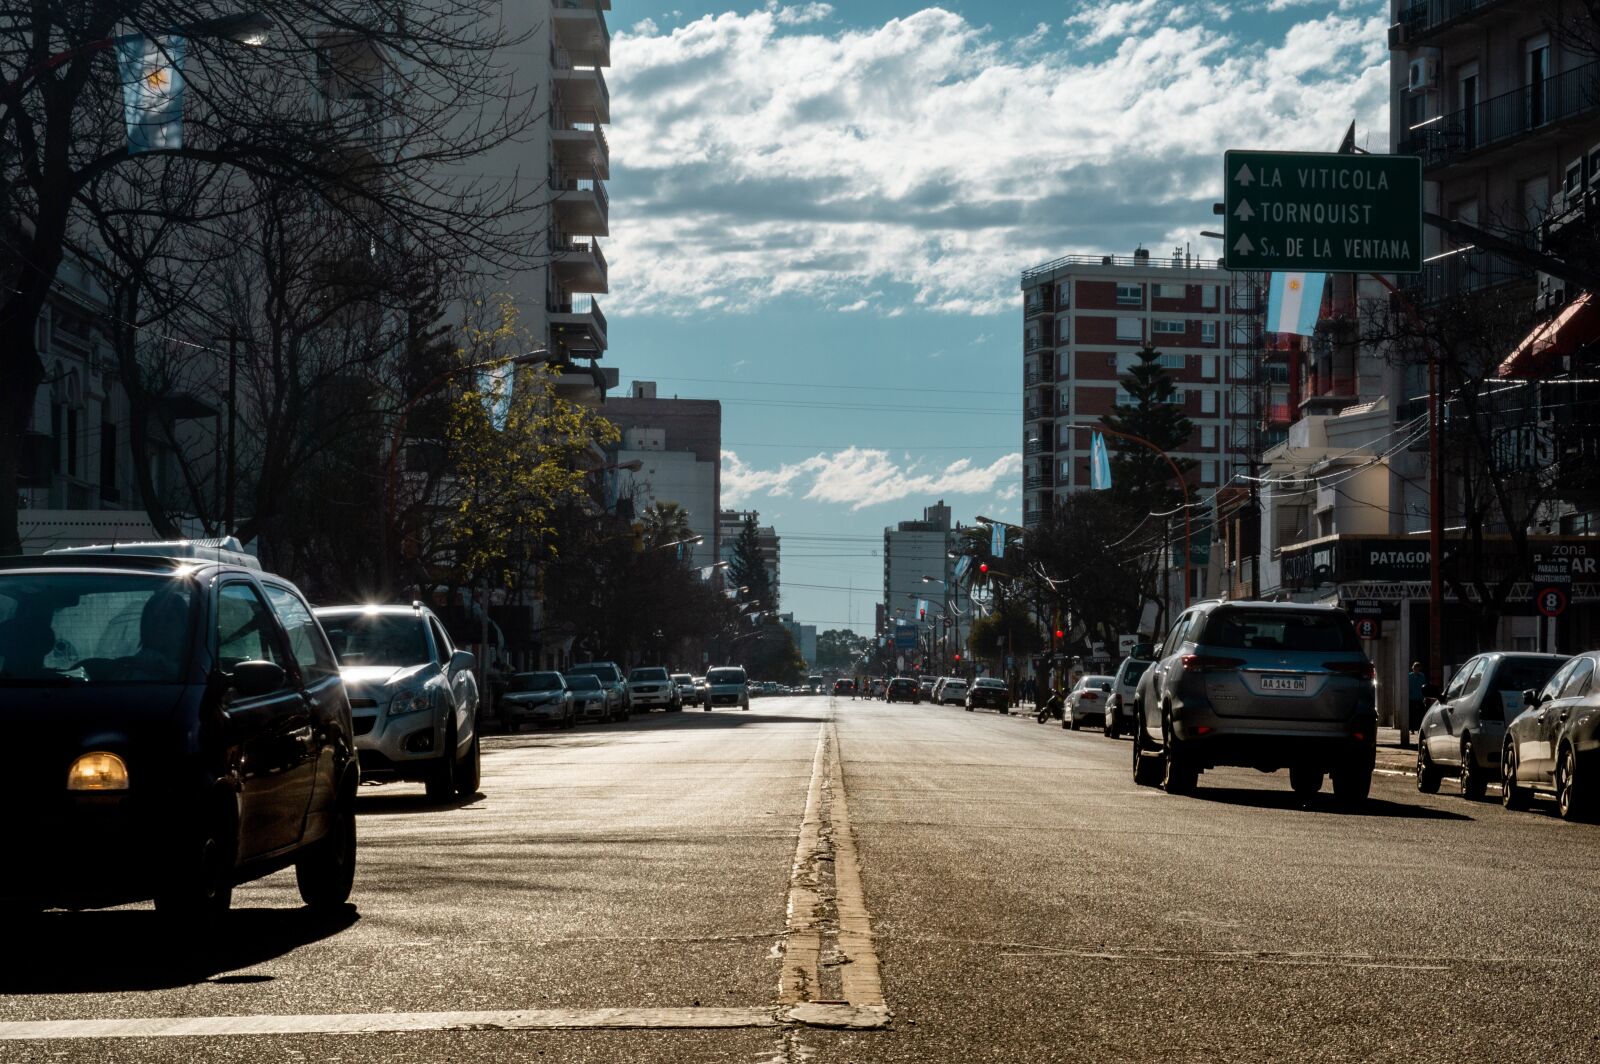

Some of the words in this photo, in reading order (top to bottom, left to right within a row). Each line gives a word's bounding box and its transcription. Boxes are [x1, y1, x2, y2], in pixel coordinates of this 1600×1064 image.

[1260, 167, 1282, 188] LA
[1298, 168, 1389, 190] VITICOLA
[1260, 202, 1372, 224] TORNQUIST
[1286, 238, 1304, 257] DE
[1313, 238, 1332, 258] LA
[1344, 239, 1411, 259] VENTANA
[1552, 545, 1587, 556] zona
[1370, 551, 1449, 565] PATAGON
[1546, 593, 1558, 607] 8
[1363, 621, 1371, 631] 8
